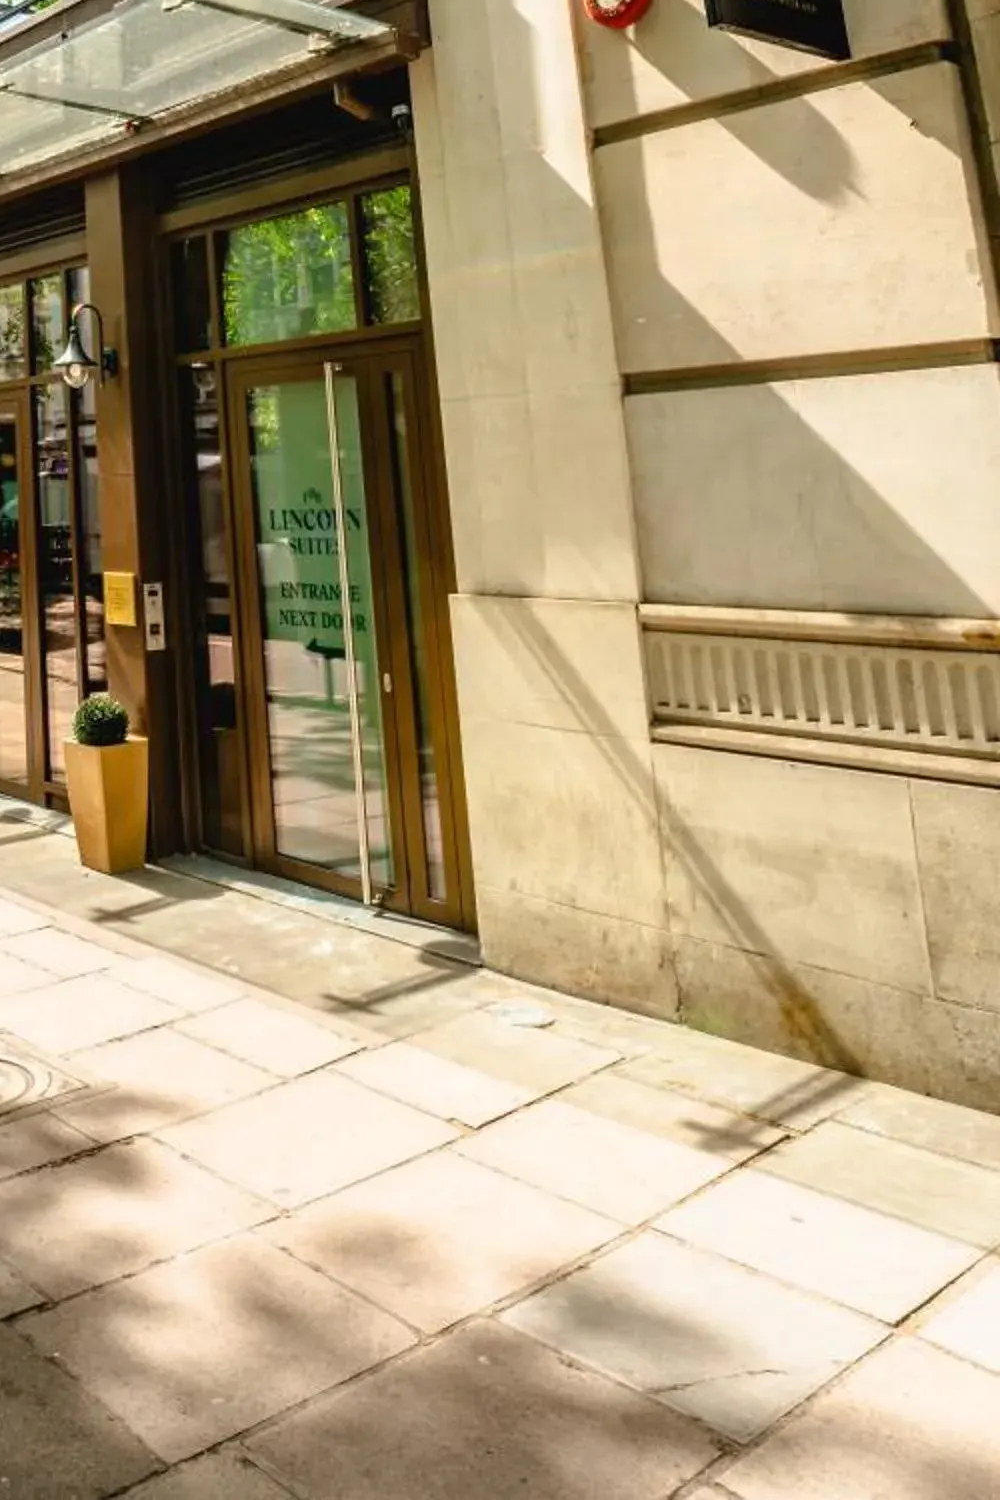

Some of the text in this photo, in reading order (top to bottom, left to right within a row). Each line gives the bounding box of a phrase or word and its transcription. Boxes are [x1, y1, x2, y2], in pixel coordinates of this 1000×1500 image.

[289, 537, 338, 555] SUITE
[281, 583, 360, 603] ENTRANE
[279, 609, 367, 632] NEXT DOR
